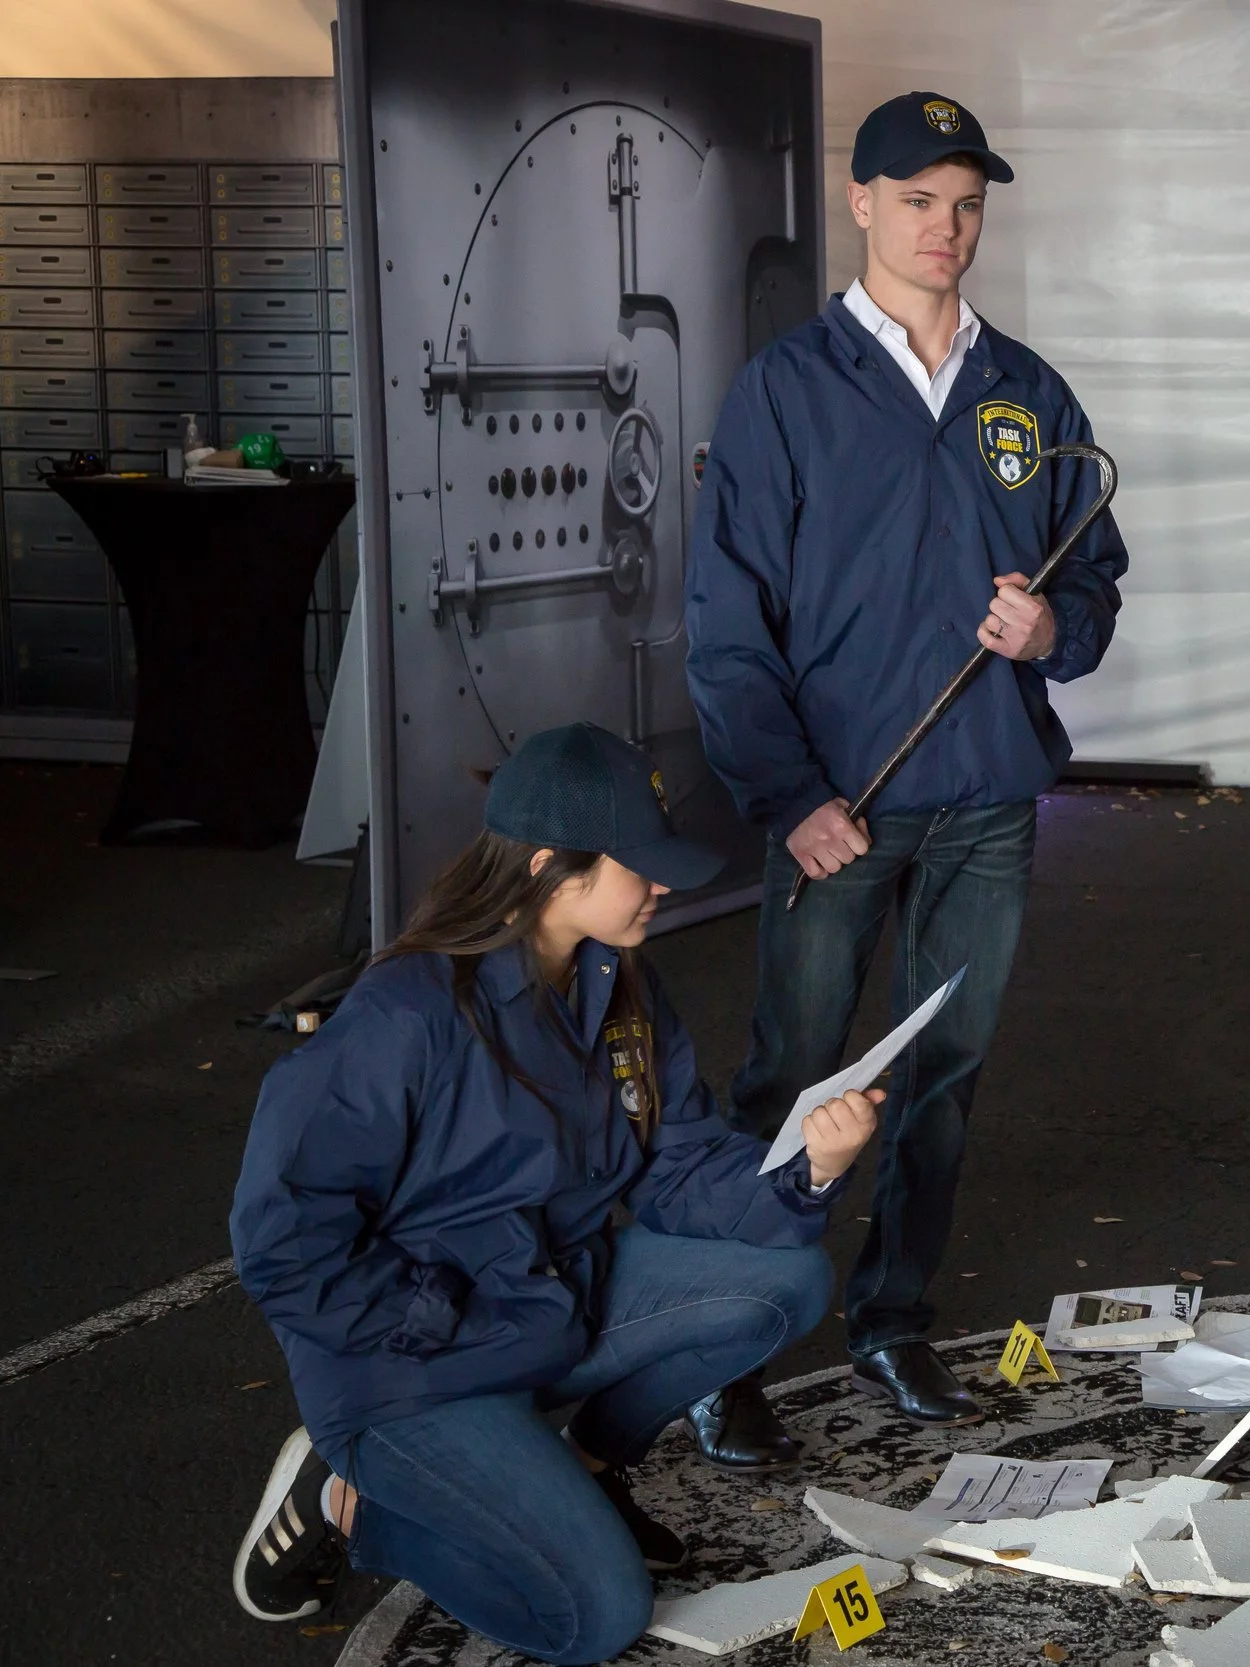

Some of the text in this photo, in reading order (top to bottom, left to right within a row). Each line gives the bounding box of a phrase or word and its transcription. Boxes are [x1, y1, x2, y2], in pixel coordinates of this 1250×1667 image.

[996, 439, 1023, 453] FORCE
[997, 426, 1020, 442] TASK
[1009, 1332, 1027, 1368] 11
[832, 1580, 869, 1627] 15
